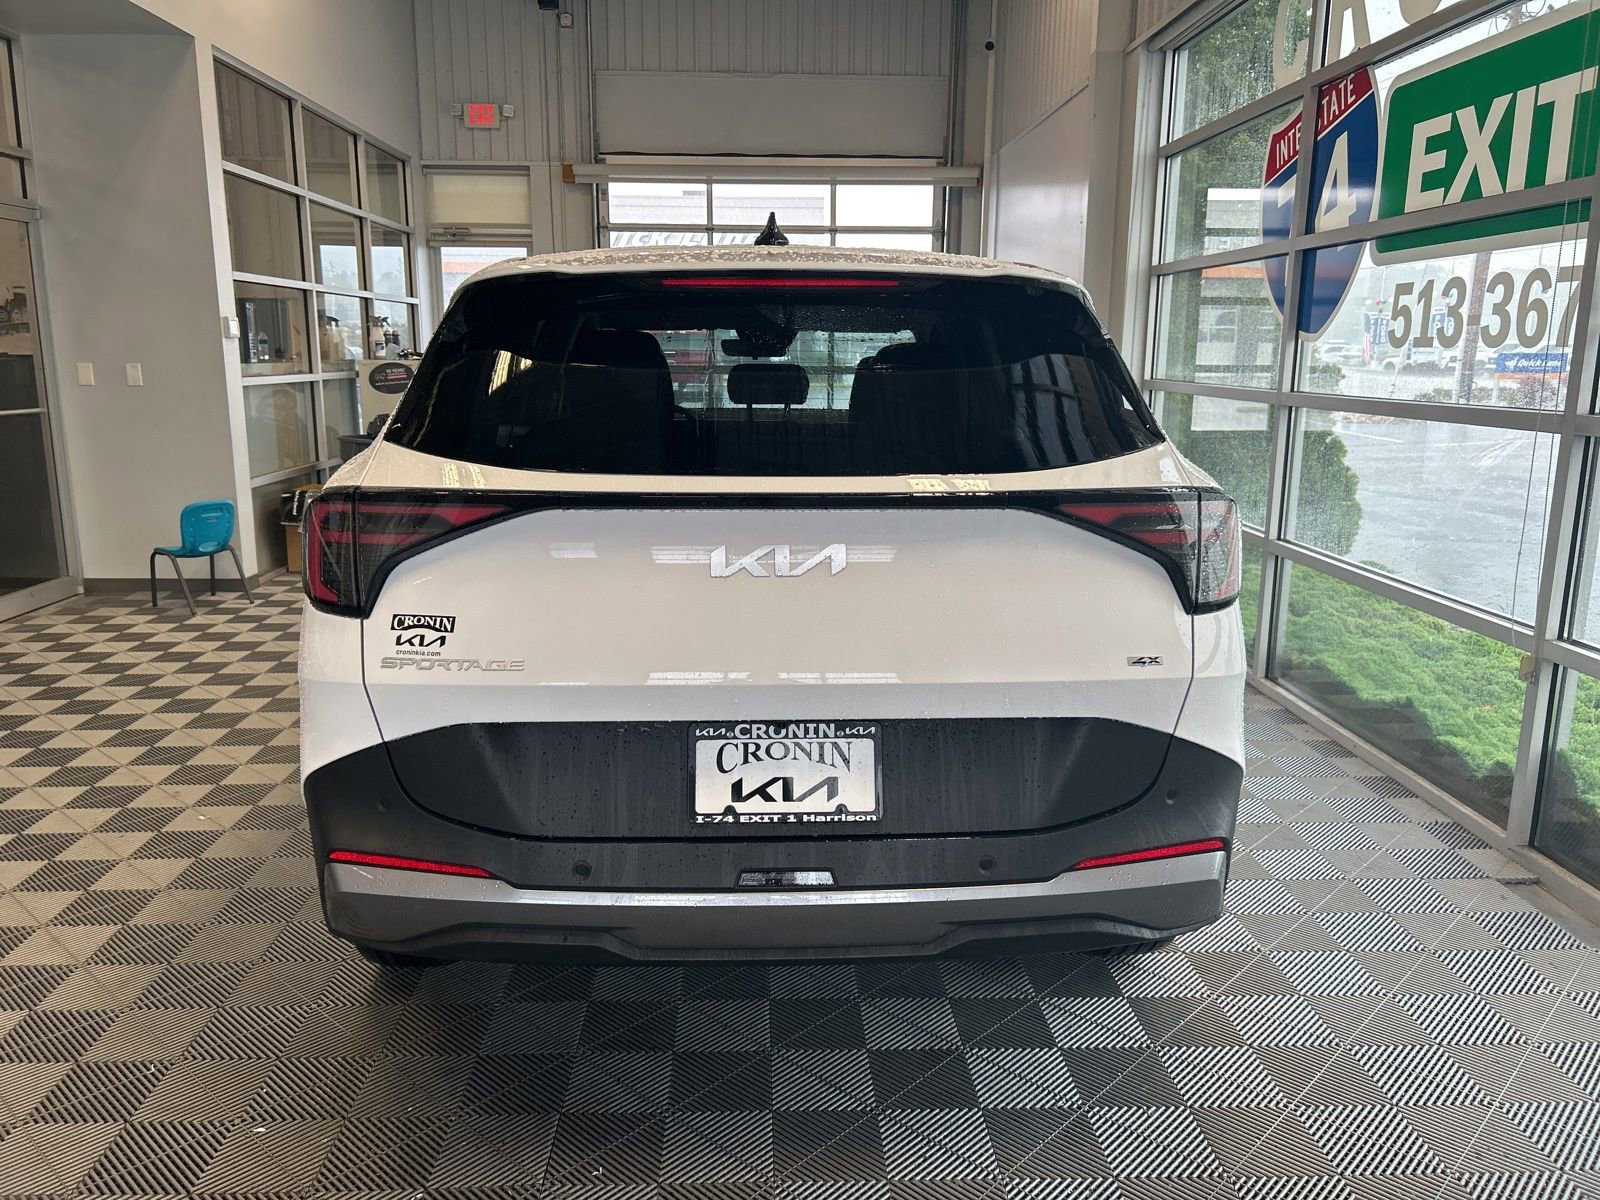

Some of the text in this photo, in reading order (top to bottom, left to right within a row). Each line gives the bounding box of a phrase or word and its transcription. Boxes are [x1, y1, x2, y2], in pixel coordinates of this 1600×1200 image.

[469, 104, 494, 125] EXIT
[1276, 78, 1357, 170] INTETATE
[1404, 67, 1599, 213] EXIT
[710, 544, 847, 577] KIA
[393, 615, 453, 632] CRONIN
[395, 634, 446, 648] KIA
[395, 649, 441, 657] croninkia.com
[380, 656, 525, 671] SPORTAGE
[734, 723, 835, 738] CRONIN
[716, 741, 855, 774] CRONIN
[731, 776, 839, 803] KIA
[696, 814, 877, 824] I-74 EXIT 1 Harrison
